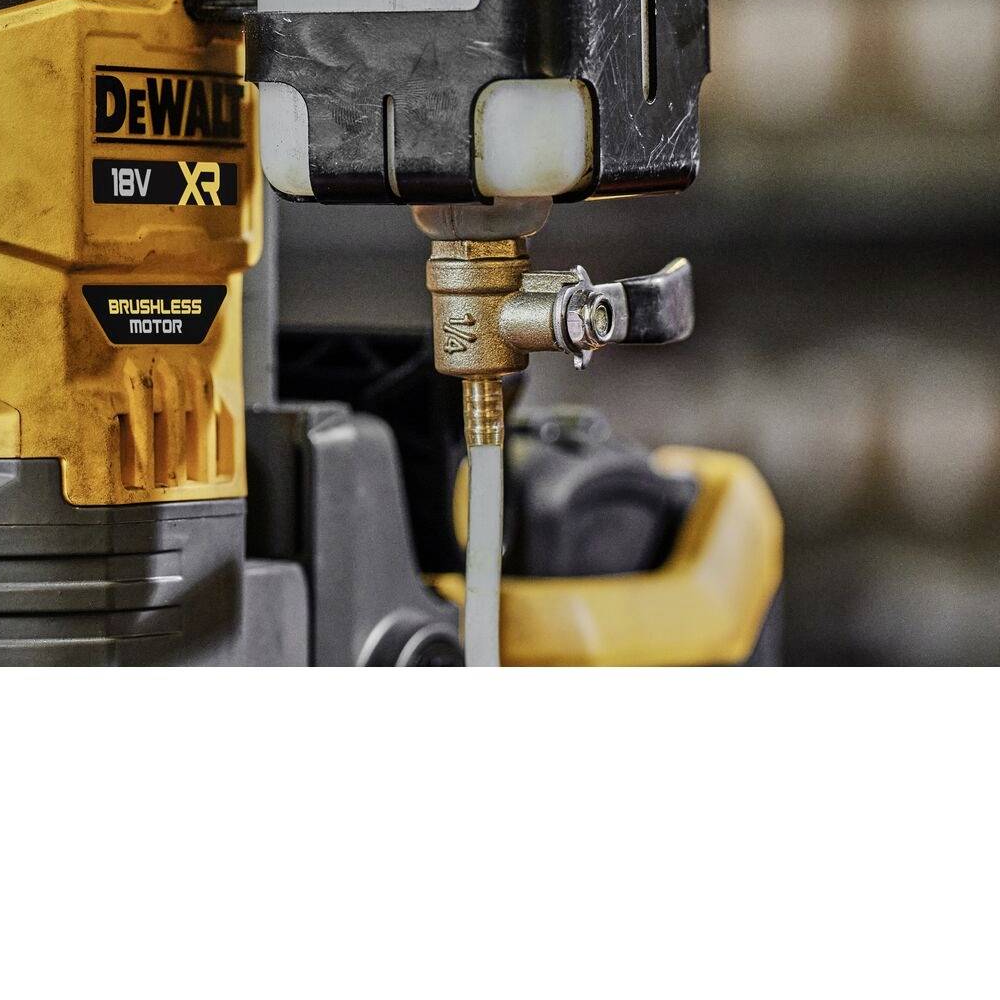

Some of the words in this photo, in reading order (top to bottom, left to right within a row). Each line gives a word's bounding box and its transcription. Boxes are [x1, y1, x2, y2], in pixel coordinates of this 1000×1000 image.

[111, 168, 151, 197] 18V
[178, 161, 221, 206] XR
[108, 299, 202, 315] BRUSHLESS
[129, 319, 182, 334] MOTOR
[443, 313, 477, 355] 1/4
